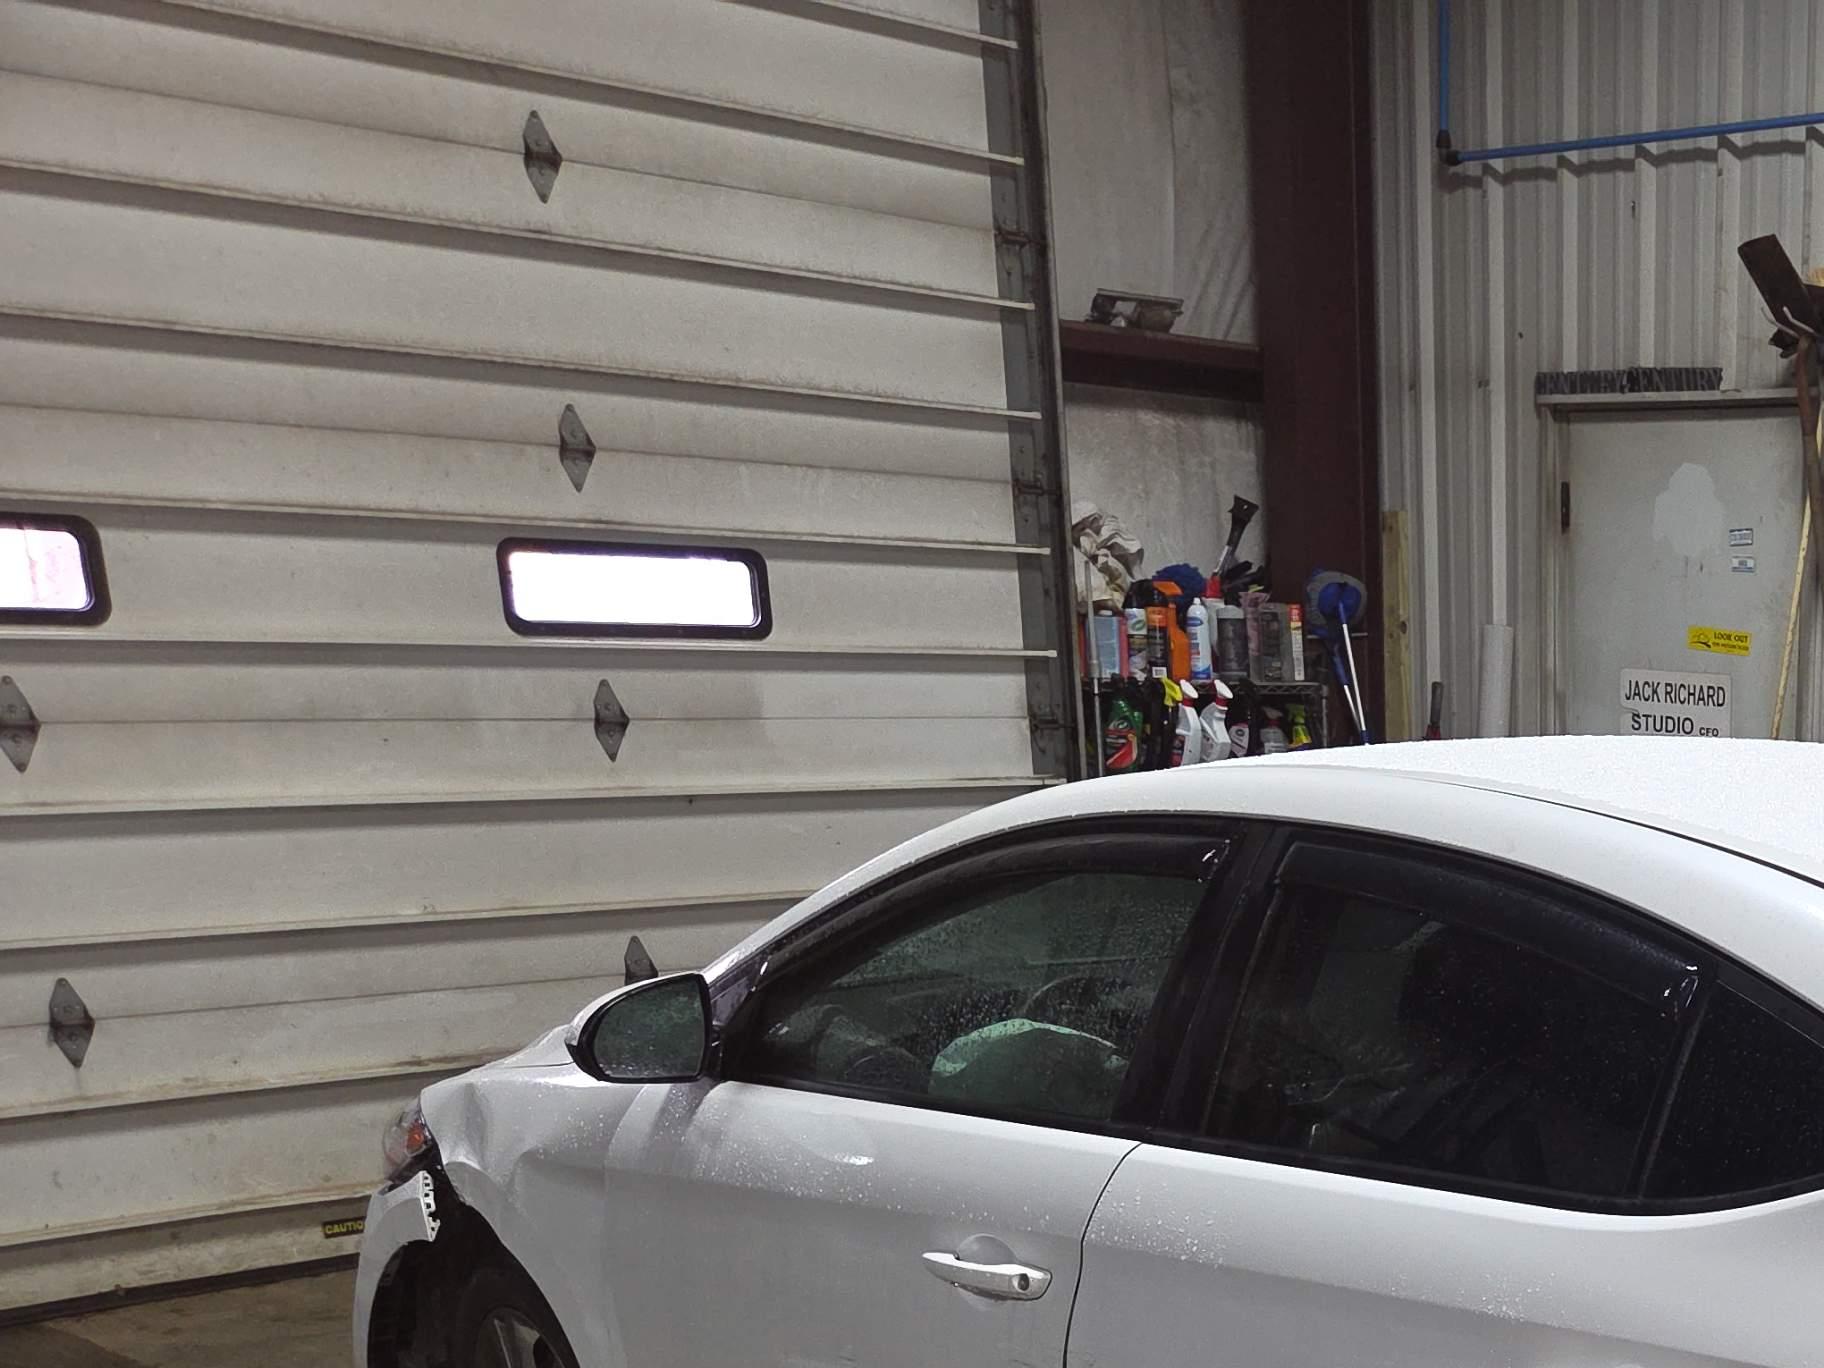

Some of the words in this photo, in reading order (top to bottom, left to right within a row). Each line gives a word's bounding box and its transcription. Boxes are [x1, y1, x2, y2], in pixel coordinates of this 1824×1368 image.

[1713, 631, 1733, 642] LOOK
[1733, 634, 1749, 643] OUT
[1624, 680, 1661, 703] JACK
[1664, 682, 1726, 707] RICHARD
[1631, 712, 1694, 735] STUDIO
[1699, 726, 1719, 737] CFO
[326, 1221, 365, 1234] CAUTIO
